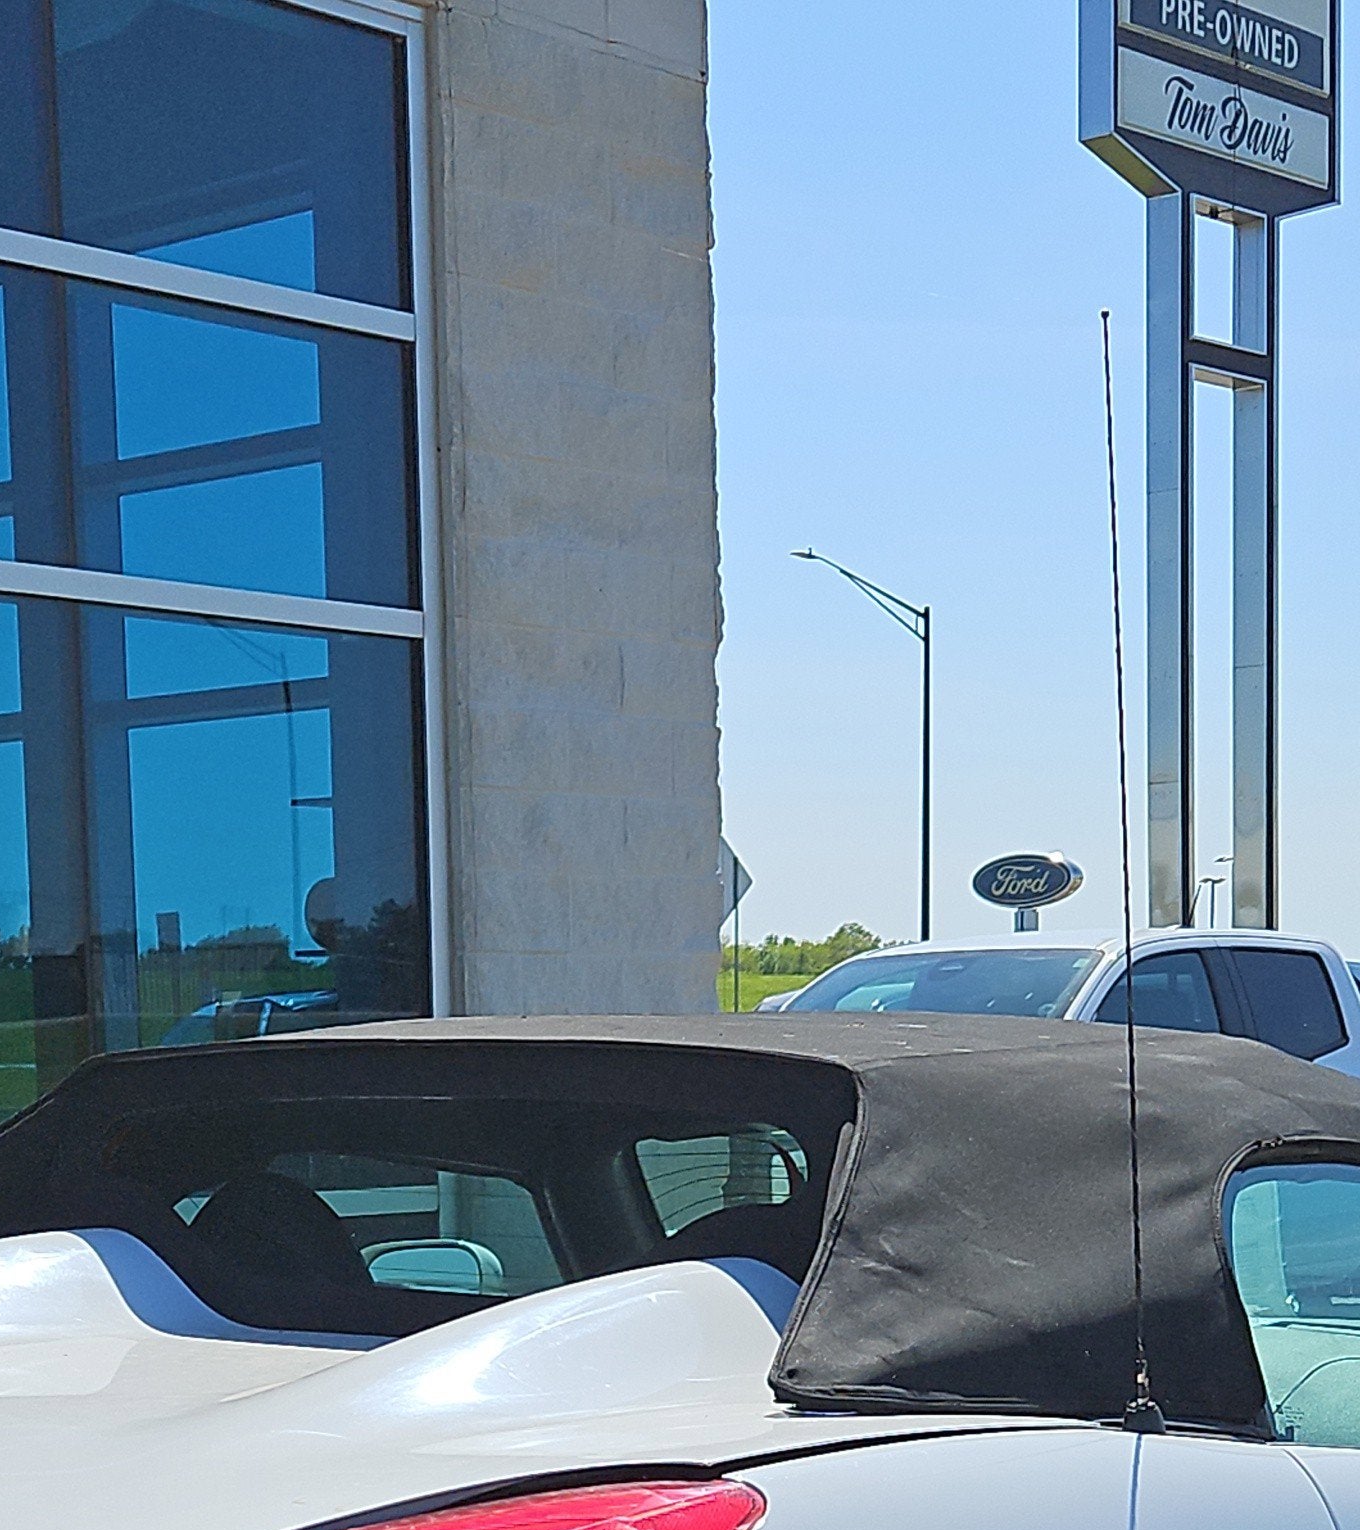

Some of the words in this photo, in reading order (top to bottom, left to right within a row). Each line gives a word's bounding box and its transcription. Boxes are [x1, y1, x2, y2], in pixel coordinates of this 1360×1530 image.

[1161, 0, 1300, 69] PRE-OWNED
[1164, 76, 1216, 141] Tom
[1219, 95, 1294, 164] Davis
[990, 865, 1050, 897] Ford
